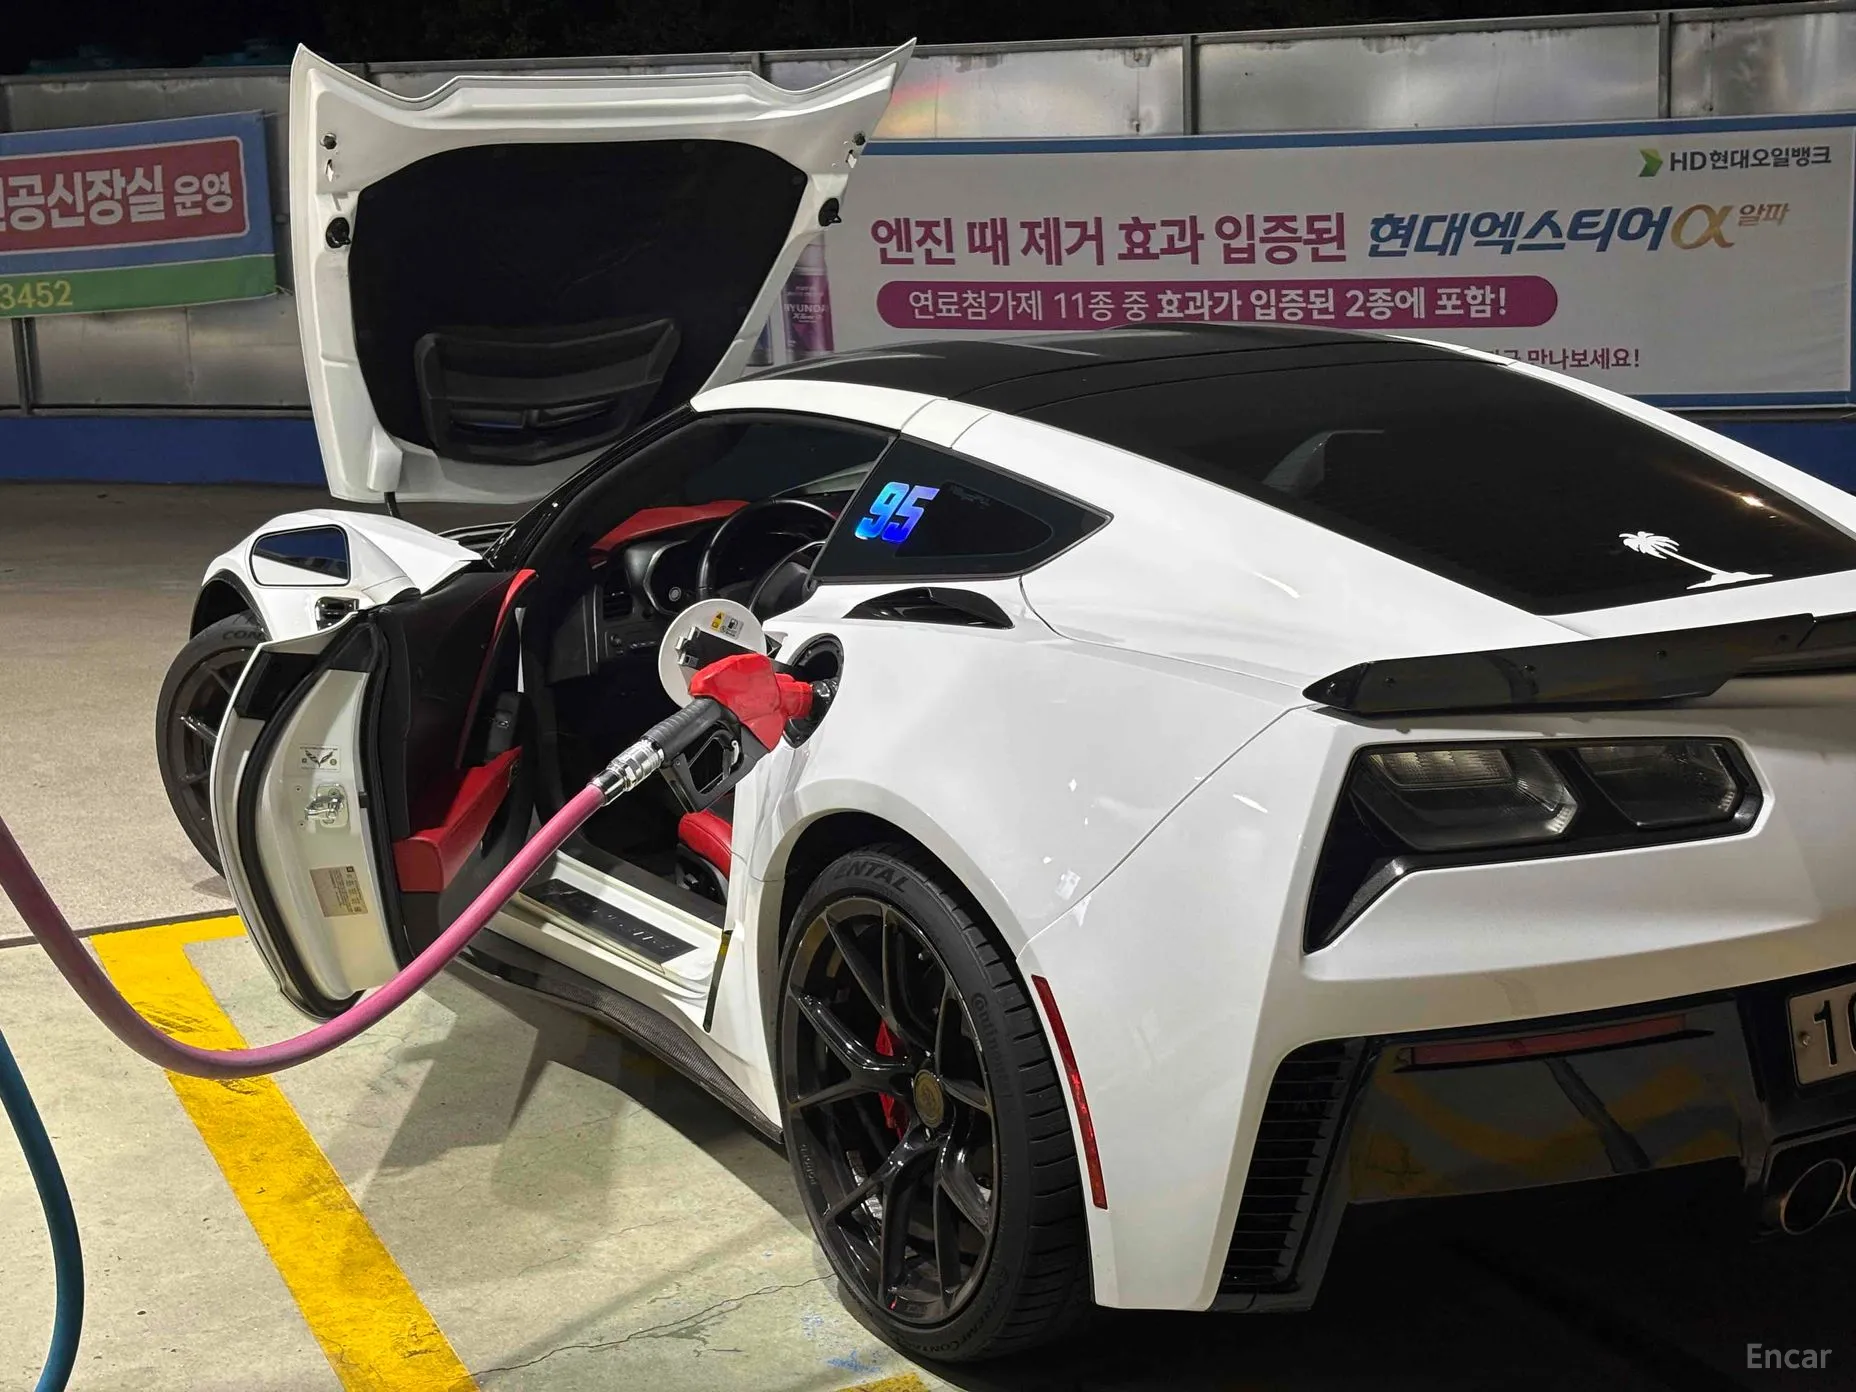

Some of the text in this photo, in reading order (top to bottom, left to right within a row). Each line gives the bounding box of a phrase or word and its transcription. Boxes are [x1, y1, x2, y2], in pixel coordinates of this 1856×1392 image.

[1669, 146, 1832, 171] HD현대오일뱅크
[174, 171, 233, 217] 운영
[871, 217, 956, 265] 엔진
[966, 217, 1010, 266] 때
[1020, 216, 1105, 266] 제거
[1118, 215, 1204, 265] 효과
[1215, 212, 1346, 265] 입증된
[1738, 203, 1790, 227] 알파
[0, 280, 73, 310] 3452
[784, 303, 829, 313] HYUNDA
[909, 285, 1506, 322] 연료첨가제 11종 중 효과가 입증된 2종에 포함!
[1528, 347, 1640, 370] 마나보세요!
[855, 481, 940, 542] 95
